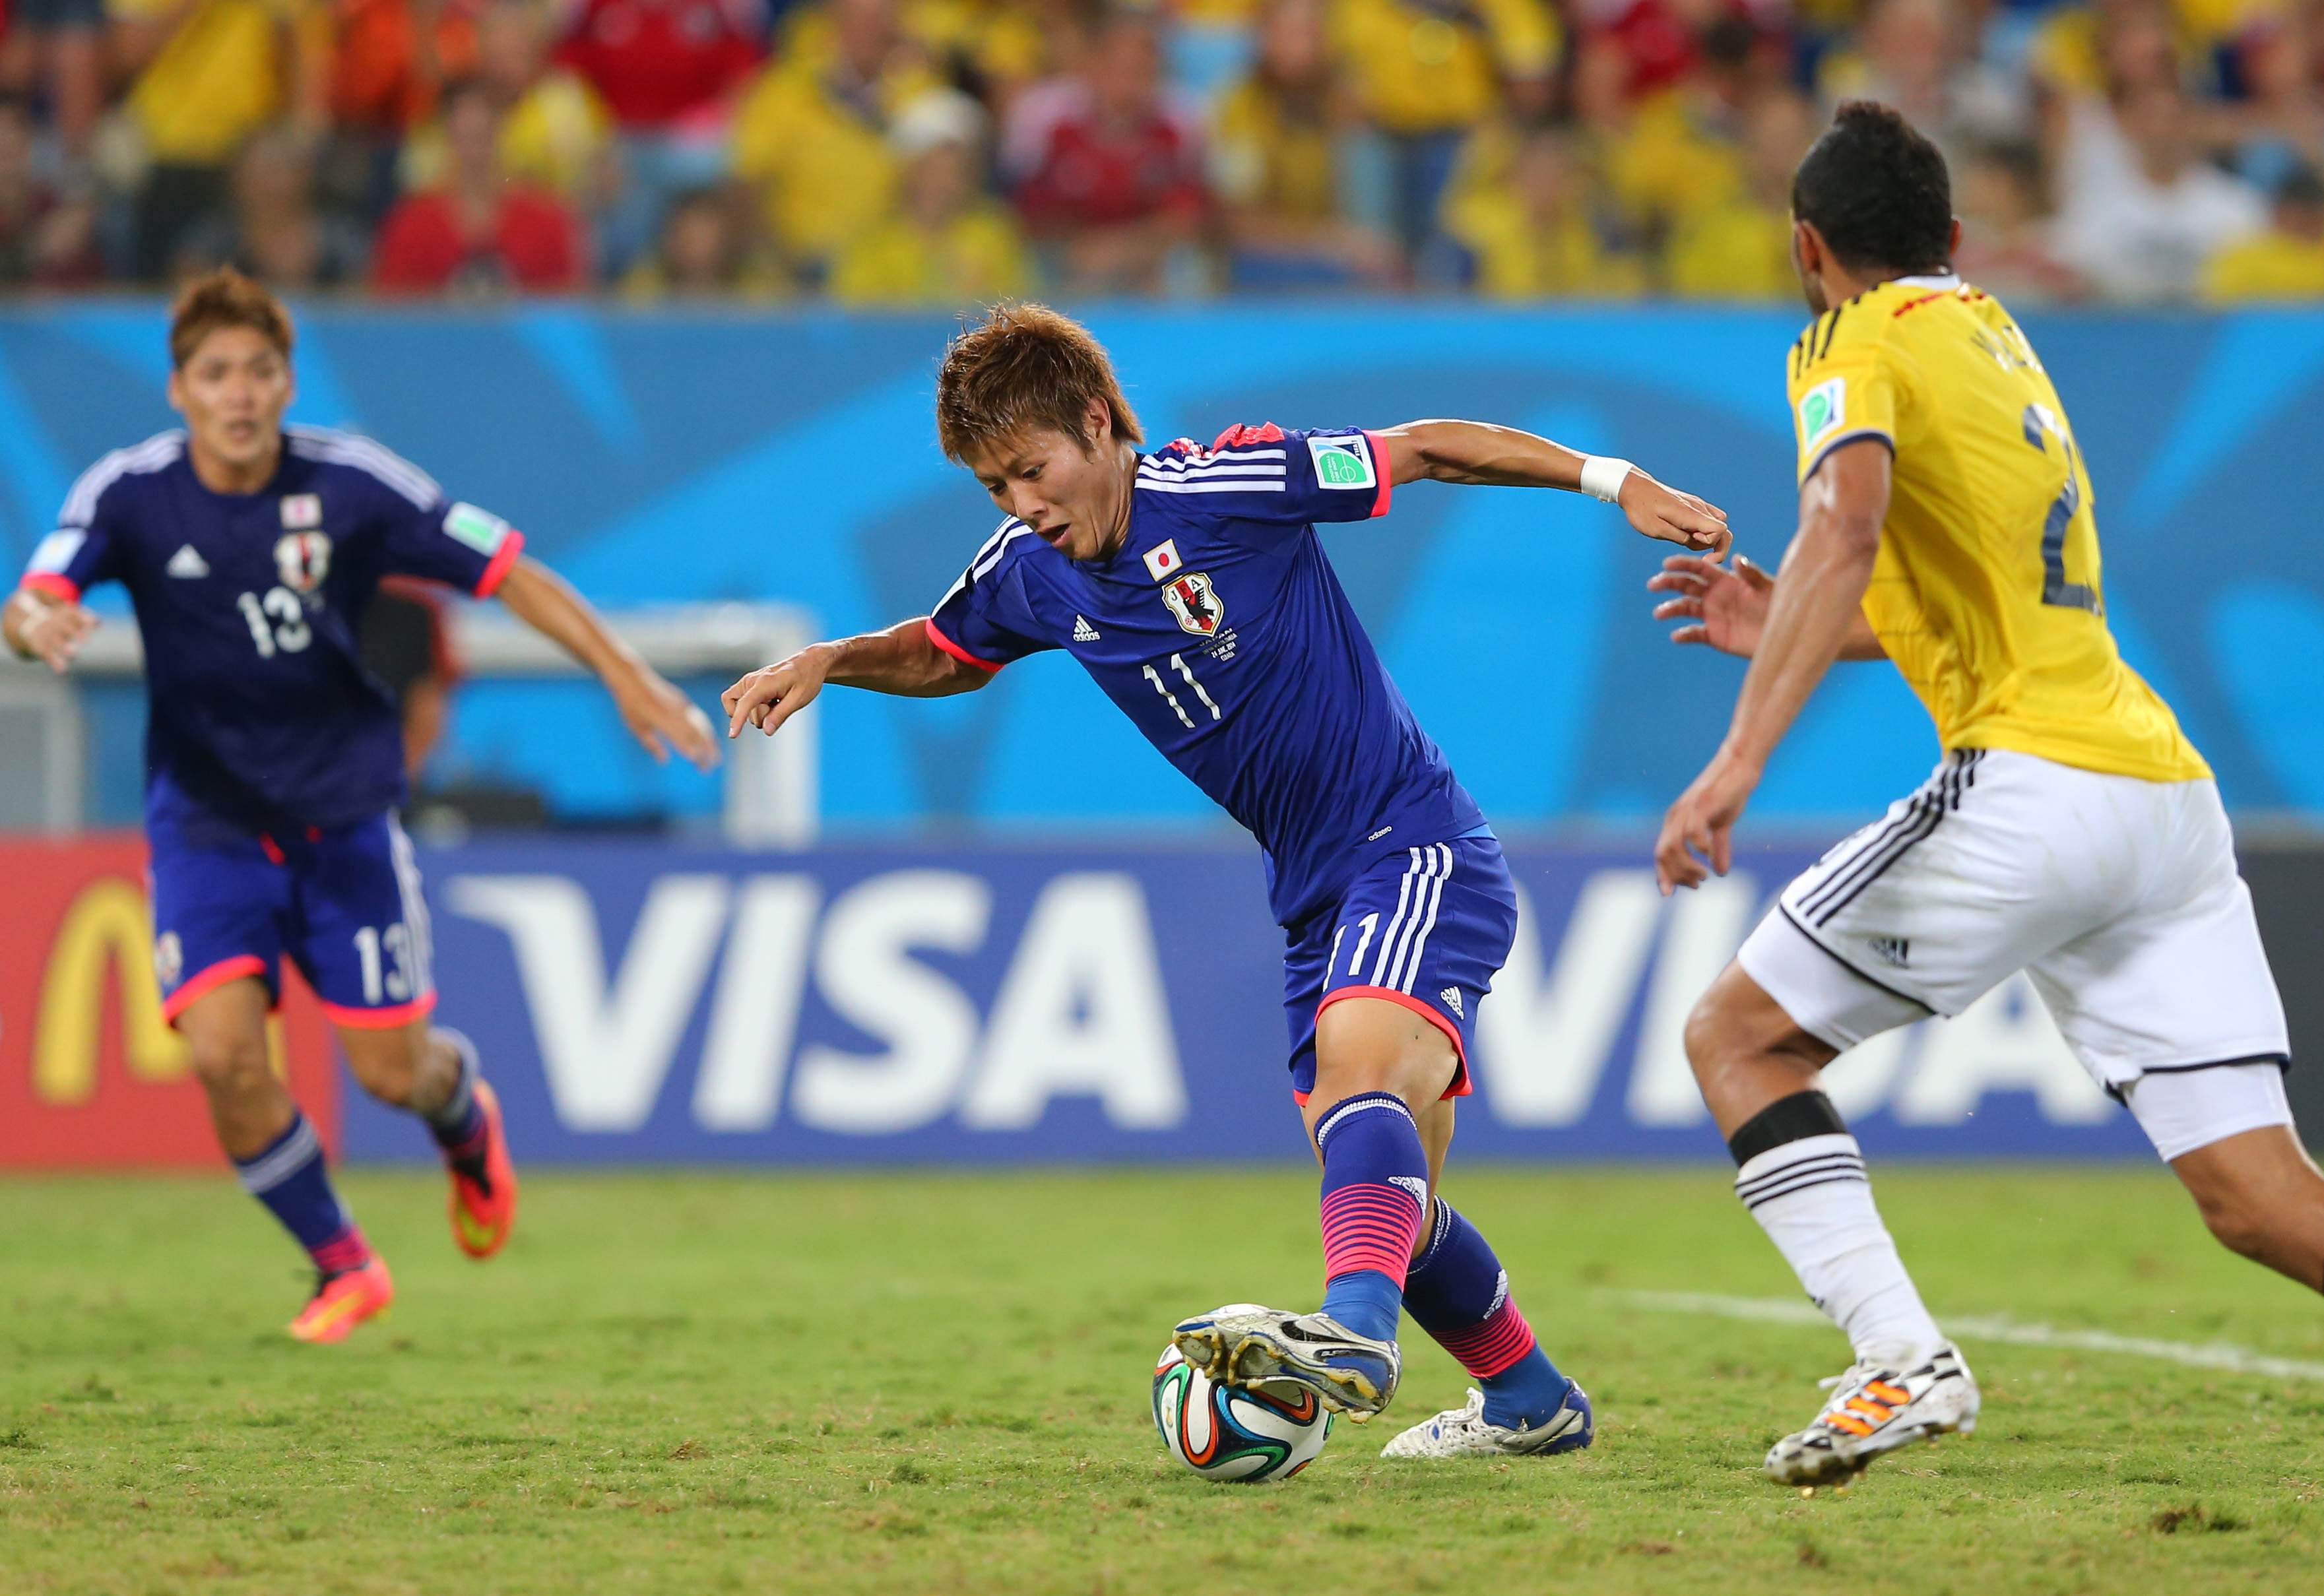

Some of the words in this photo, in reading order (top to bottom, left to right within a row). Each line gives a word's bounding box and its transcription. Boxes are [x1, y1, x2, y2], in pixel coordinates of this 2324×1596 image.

[238, 586, 312, 658] 13
[1073, 631, 1101, 641] adidas
[1142, 653, 1221, 728] 11
[354, 922, 414, 1005] 13
[1322, 912, 1380, 993] 11
[442, 870, 1188, 1133] VISA
[1475, 870, 2122, 1128] VIA
